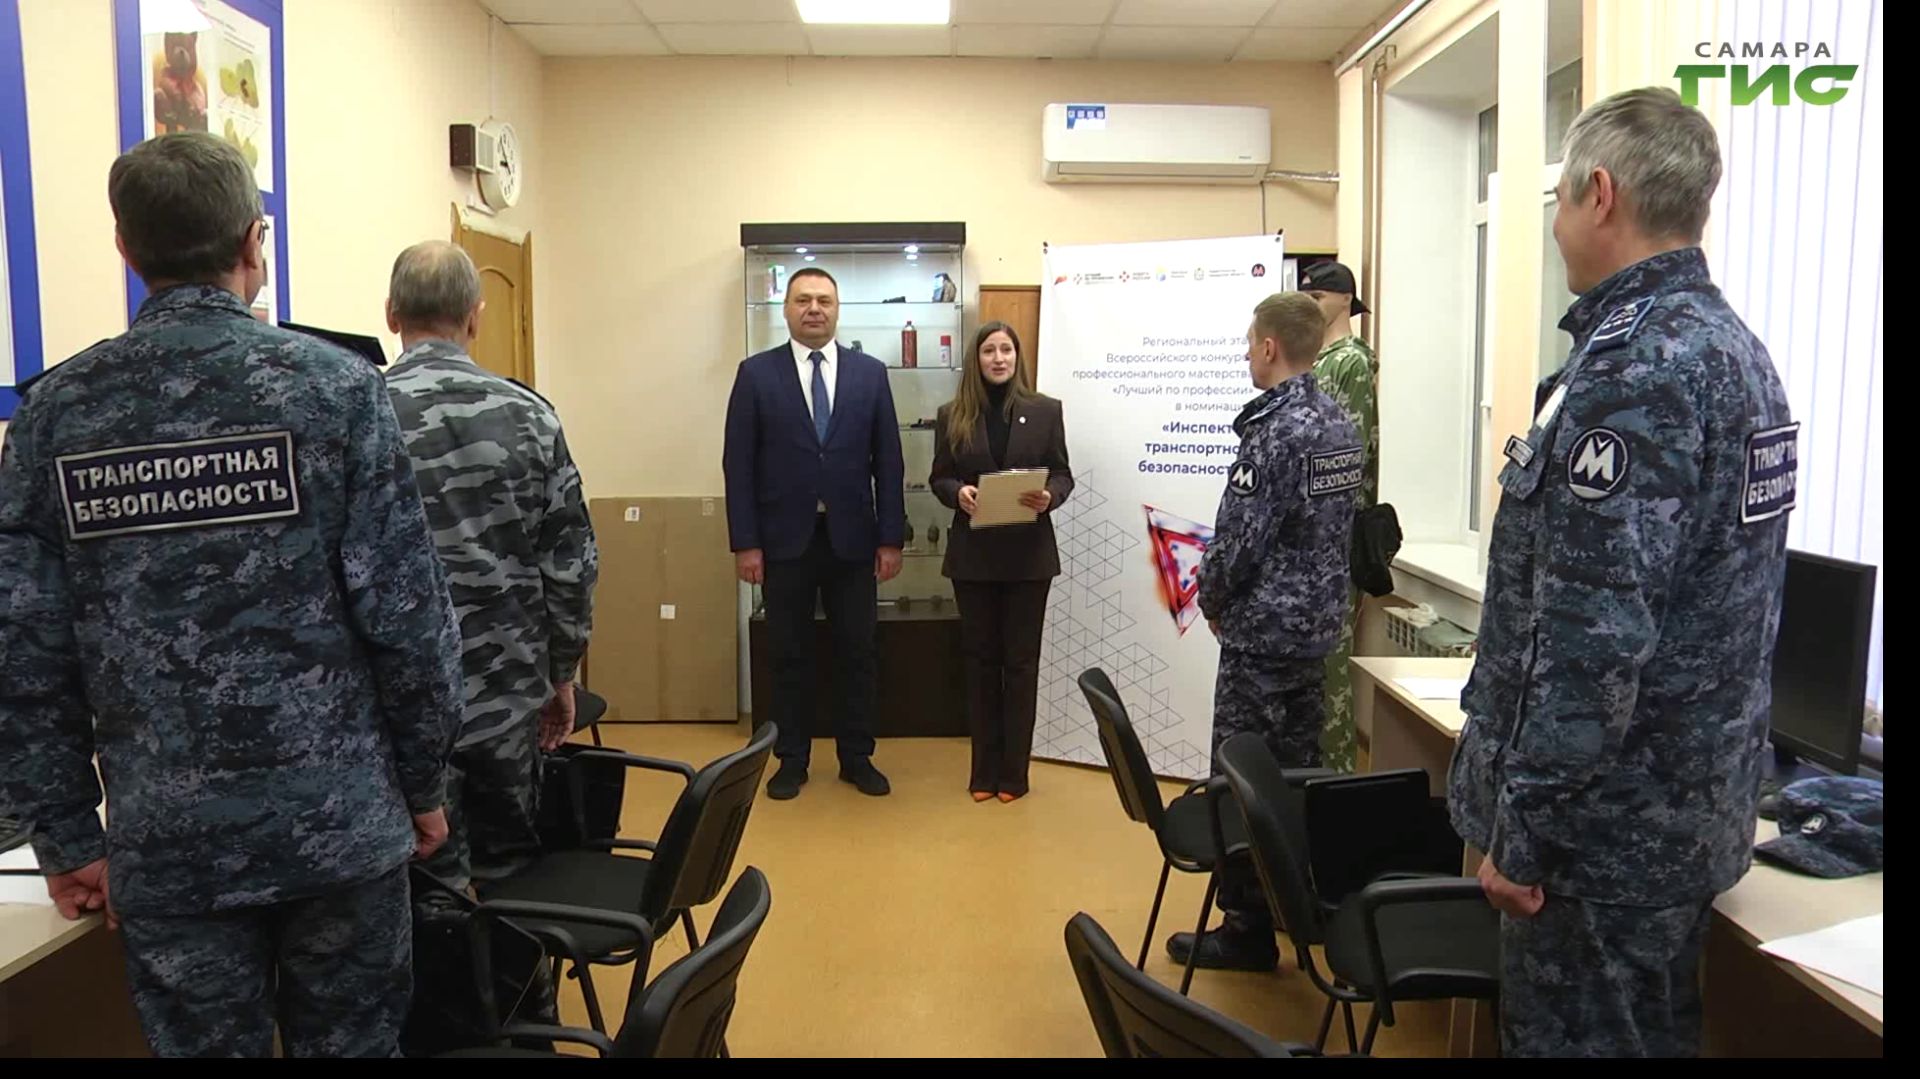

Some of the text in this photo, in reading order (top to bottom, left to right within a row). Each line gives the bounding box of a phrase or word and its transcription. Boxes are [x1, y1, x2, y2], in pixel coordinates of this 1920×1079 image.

[1142, 336, 1248, 347] Региональный эта
[1106, 352, 1198, 364] Всероссийского
[1072, 369, 1186, 380] профессионального
[1112, 384, 1163, 396] «Лучший
[1166, 386, 1180, 395] по
[1185, 402, 1243, 413] номинаци
[1162, 420, 1233, 434] «Инспект
[1145, 442, 1241, 457] транспортно
[72, 446, 279, 490] ТРАНСПОРТНАЯ
[1138, 460, 1230, 475] безопасност
[73, 479, 288, 523] БЕЗОПАСНОСТЬ
